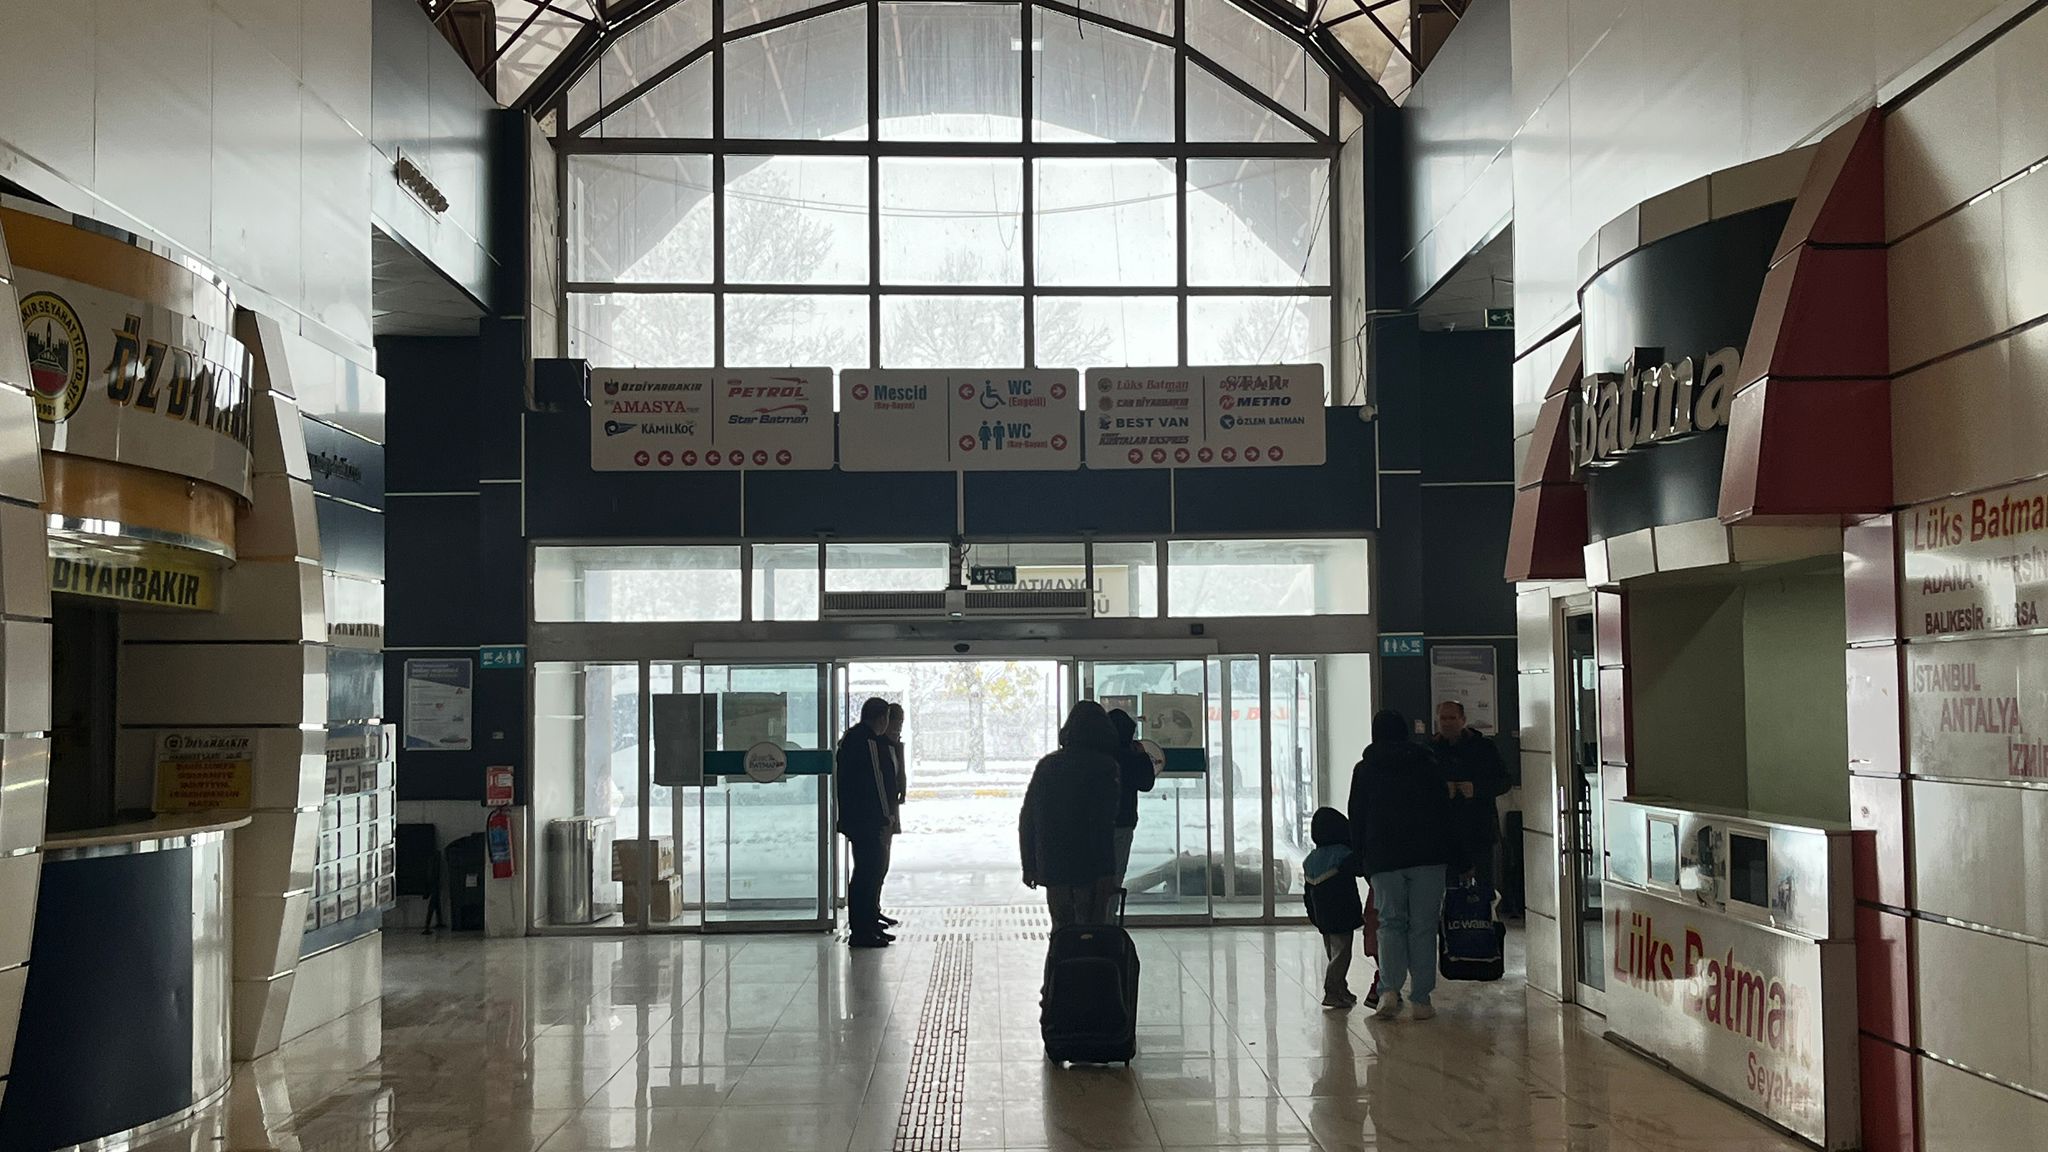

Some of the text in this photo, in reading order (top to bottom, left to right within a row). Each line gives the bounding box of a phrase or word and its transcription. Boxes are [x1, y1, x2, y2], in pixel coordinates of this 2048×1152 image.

[40, 301, 76, 334] SEYAHAT
[1008, 380, 1032, 395] WC
[1117, 379, 1189, 390] Lüks Batman
[728, 387, 804, 398] PETROL
[874, 385, 927, 400] Mescid
[612, 401, 686, 413] AMASYA
[1236, 396, 1292, 407] METRO
[728, 414, 808, 424] Star Batman
[1116, 417, 1189, 428] BEST VAN
[1236, 416, 1305, 426] ÖZLEM BATMAN
[1007, 423, 1032, 438] WC
[1914, 494, 2048, 551] Lüks Batma
[1925, 604, 1985, 634] BALIKESİR
[1941, 697, 2023, 734] ANTALYA
[1613, 908, 1675, 1004] Lüks
